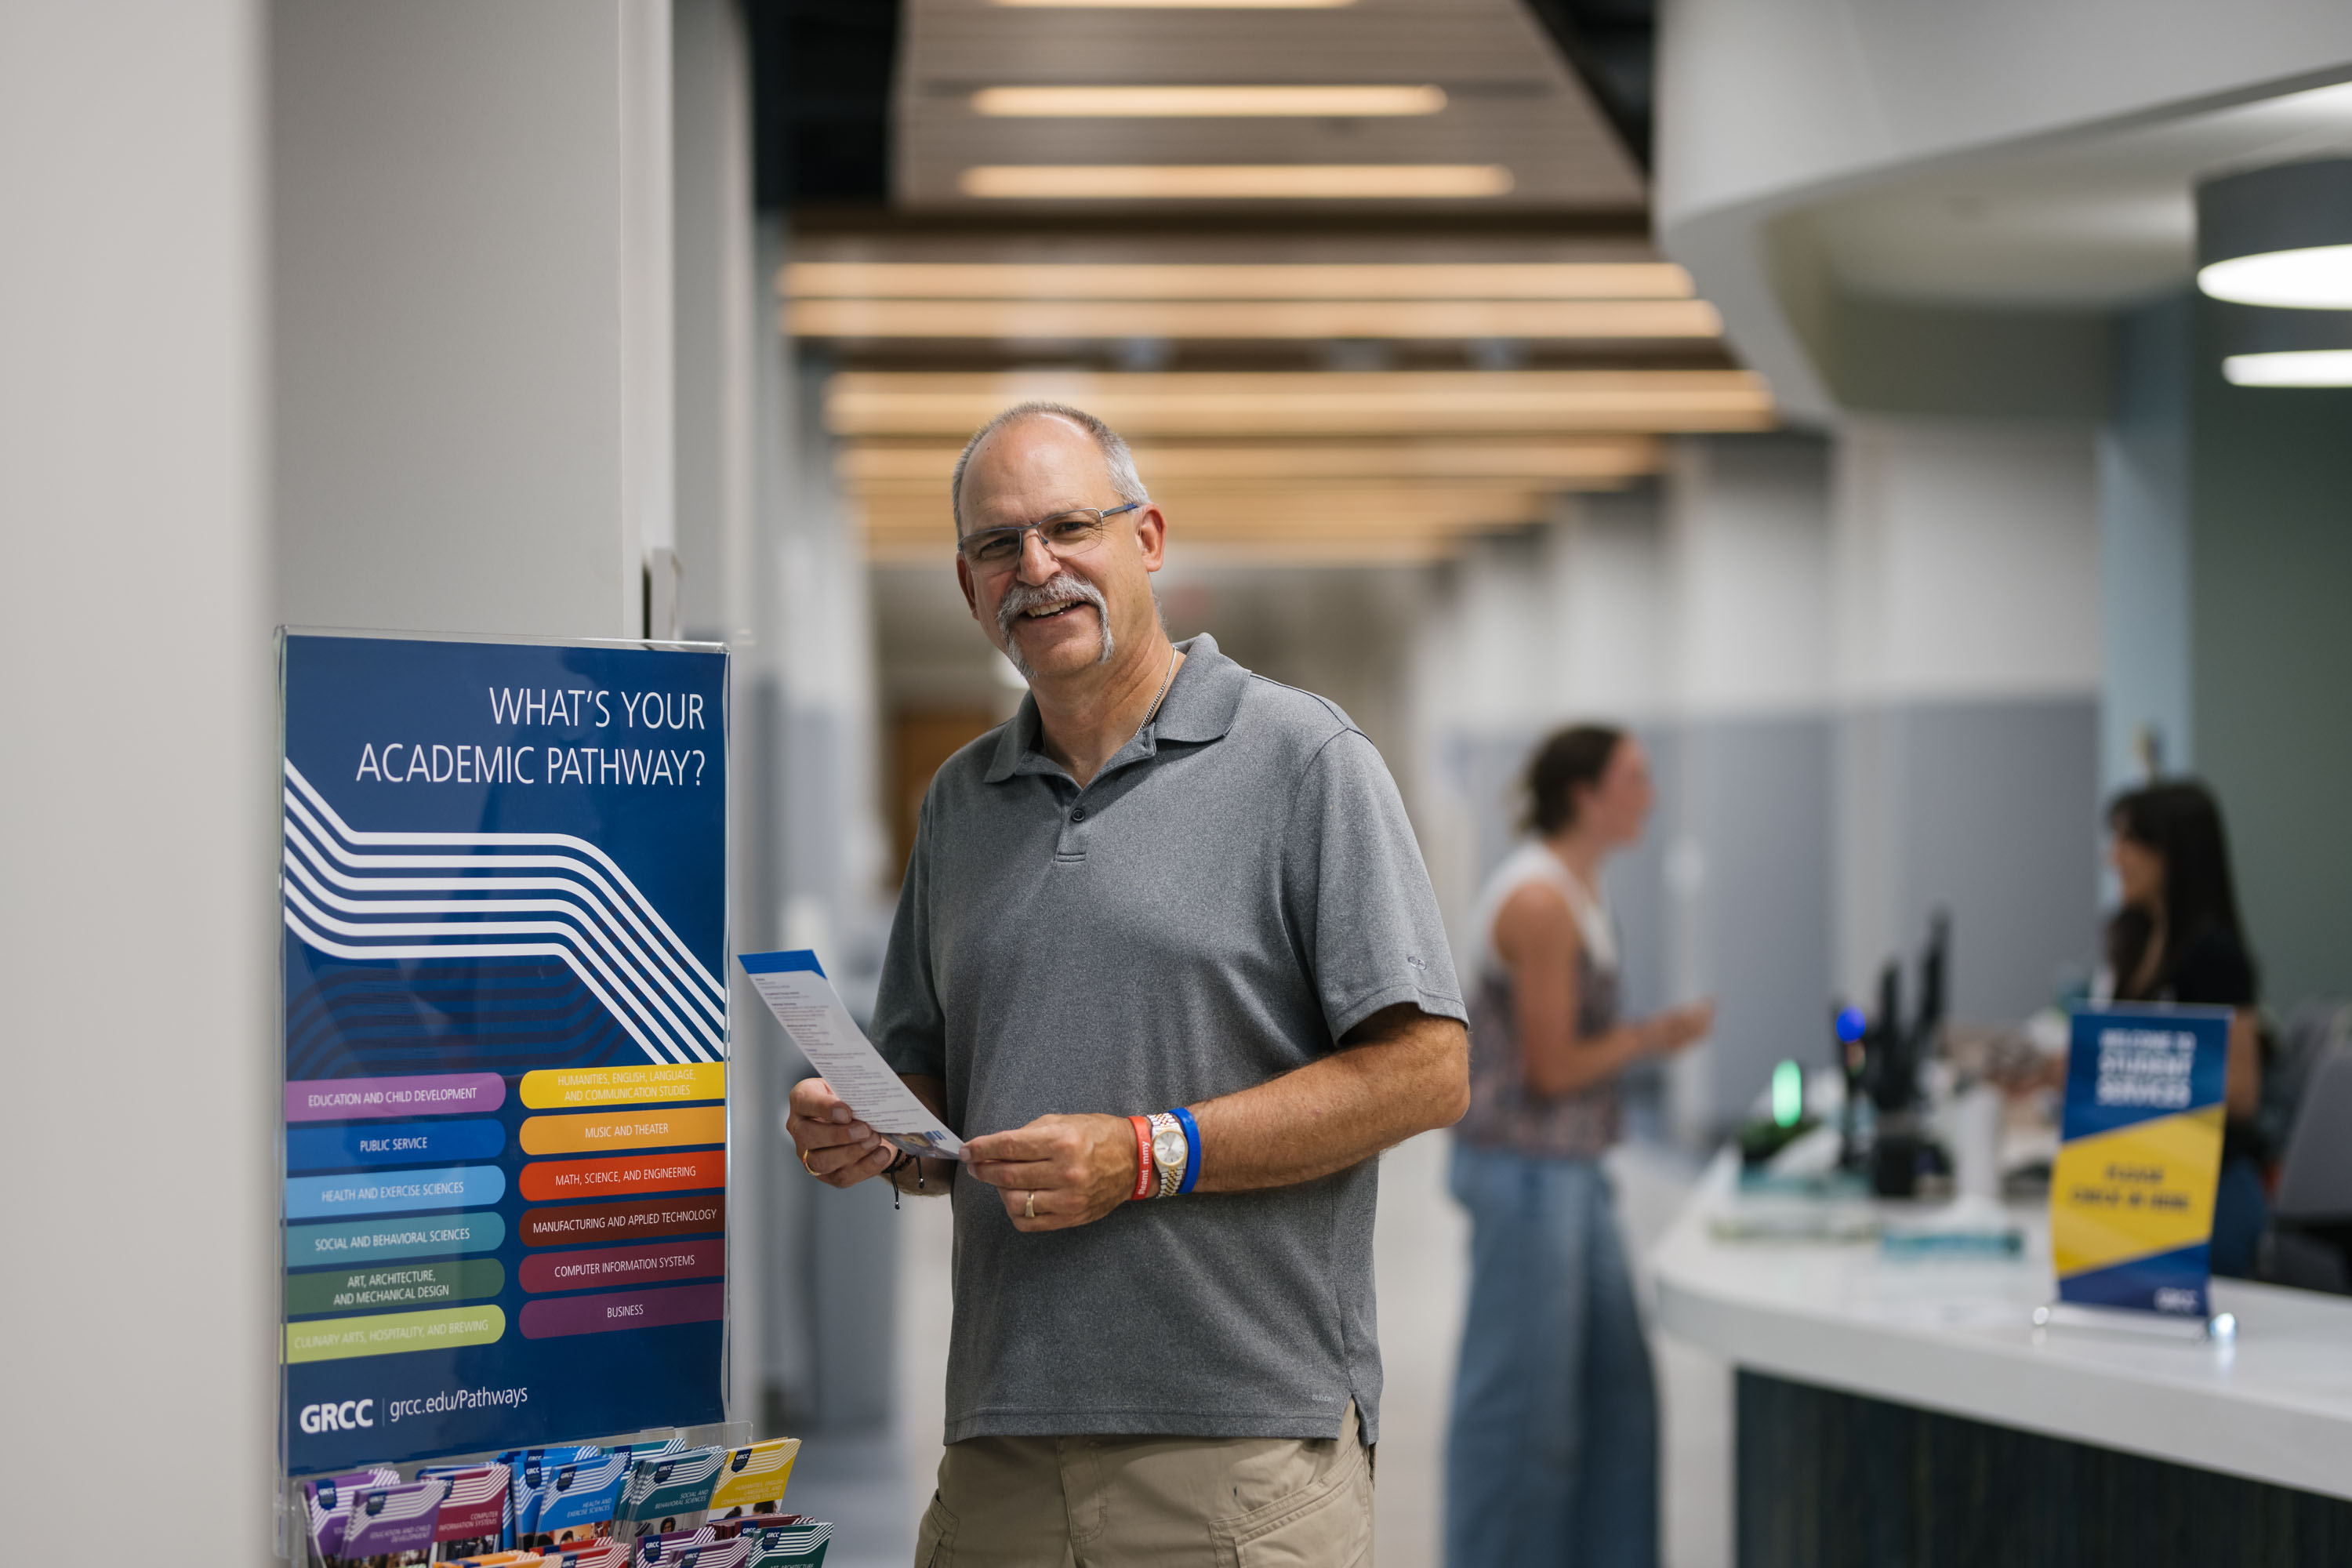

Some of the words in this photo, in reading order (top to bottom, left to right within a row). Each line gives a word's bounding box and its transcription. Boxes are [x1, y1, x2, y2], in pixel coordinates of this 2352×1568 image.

[488, 687, 611, 728] WHAT'S
[621, 691, 706, 730] YOUR
[355, 742, 535, 784] ACADEMIC
[548, 746, 706, 786] PATHWAY?
[557, 1073, 610, 1086] HUMANITIES,
[612, 1072, 648, 1084] ENGLISH,
[650, 1069, 696, 1081] LANGUAGE,
[308, 1093, 361, 1108] EDUCATION
[364, 1091, 384, 1104] AND
[385, 1090, 412, 1103] CHILD
[414, 1087, 477, 1102] DEVELOPMENT
[564, 1090, 583, 1102] AND
[585, 1087, 657, 1101] COMMUNICATION
[659, 1084, 691, 1097] STUDIES
[585, 1126, 612, 1138] MUSIC
[614, 1125, 633, 1136] AND
[634, 1123, 669, 1135] THEATER
[360, 1139, 390, 1152] PUBLIC
[393, 1137, 428, 1150] SERVICE
[555, 1174, 582, 1187] MATH,
[584, 1171, 621, 1185] SCIENCE,
[623, 1169, 641, 1181] AND
[644, 1166, 696, 1180] ENGINEERING
[321, 1189, 356, 1203] HEALTH
[358, 1187, 378, 1200] AND
[380, 1185, 421, 1199] EXERCISE
[423, 1181, 464, 1196] SCIENCES
[533, 1217, 605, 1234] MANUFACTURING
[607, 1215, 626, 1228] AND
[628, 1212, 660, 1225] APPLIED
[662, 1209, 717, 1224] TECHNOLOGY
[315, 1237, 348, 1251] SOCIAL
[350, 1235, 371, 1248] AND
[372, 1231, 427, 1247] BEHAVIORAL
[430, 1228, 470, 1242] SCIENCES
[554, 1262, 601, 1277] COMPUTER
[602, 1258, 657, 1273] INFORMATION
[659, 1254, 695, 1268] SYSTEMS
[347, 1275, 367, 1288] ART,
[368, 1269, 436, 1286] ARCHITECTURE,
[333, 1294, 354, 1306] AND
[356, 1288, 416, 1304] MECHANICAL
[417, 1284, 449, 1298] DESIGN
[607, 1304, 644, 1318] BUSINESS
[294, 1334, 339, 1349] CULINARY
[342, 1331, 367, 1345] ARTS,
[369, 1326, 425, 1342] HOSPITALITY,
[427, 1323, 447, 1336] AND
[448, 1319, 488, 1334] BREWING
[390, 1386, 528, 1422] grcc.edu/Pathways
[299, 1399, 374, 1434] GRCC
[583, 1499, 601, 1508] HEALTH
[655, 1499, 684, 1510] BEHAVIORAL
[684, 1496, 707, 1504] SCIENCES
[680, 1491, 697, 1500] SOCIAL
[470, 1511, 499, 1521] COMPUTER
[567, 1508, 588, 1519] EXERCISE
[589, 1504, 611, 1514] SCIENCES
[438, 1521, 474, 1531] INFORMATION
[475, 1518, 497, 1526] SYSTEMS
